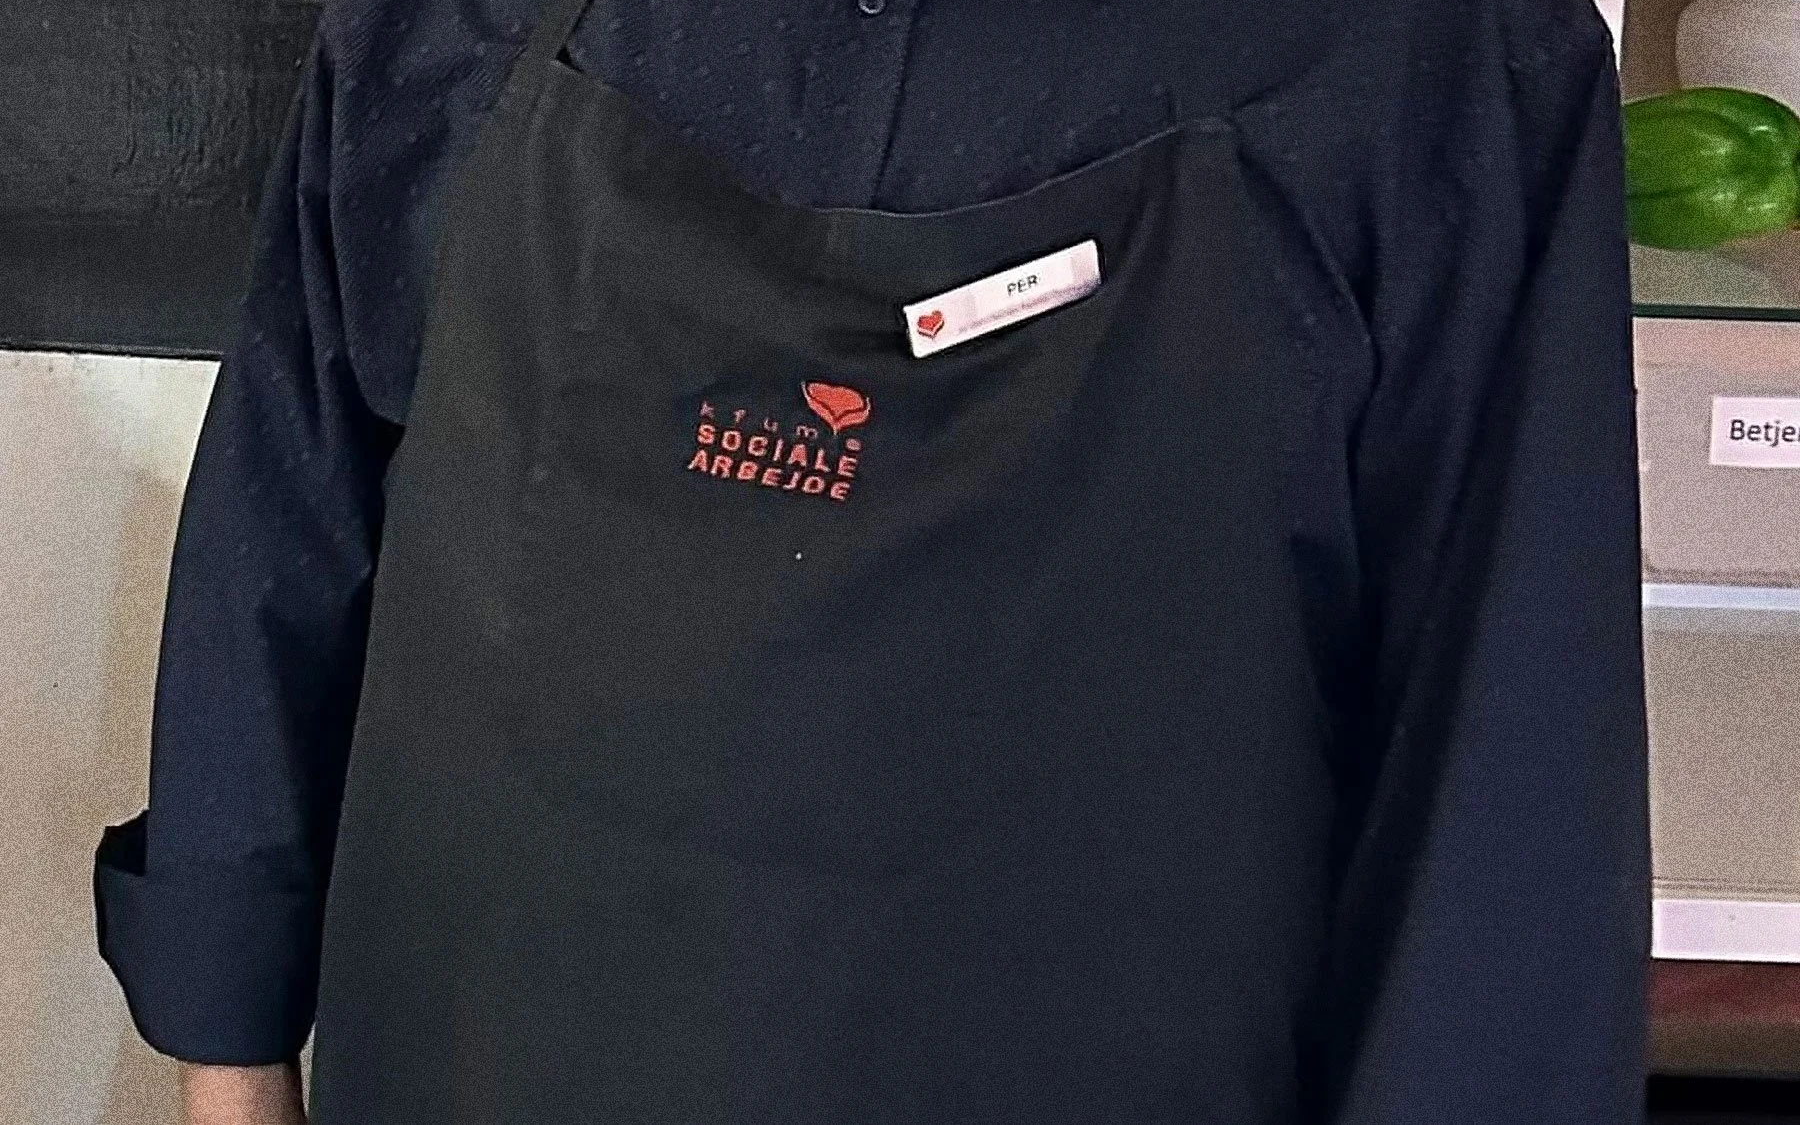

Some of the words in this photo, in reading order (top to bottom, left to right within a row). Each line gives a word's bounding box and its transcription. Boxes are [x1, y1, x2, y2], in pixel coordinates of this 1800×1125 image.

[1006, 275, 1038, 297] PER
[697, 423, 859, 477] SOCIALE
[1729, 418, 1800, 448] Betje
[687, 448, 851, 501] ARBEJDE
